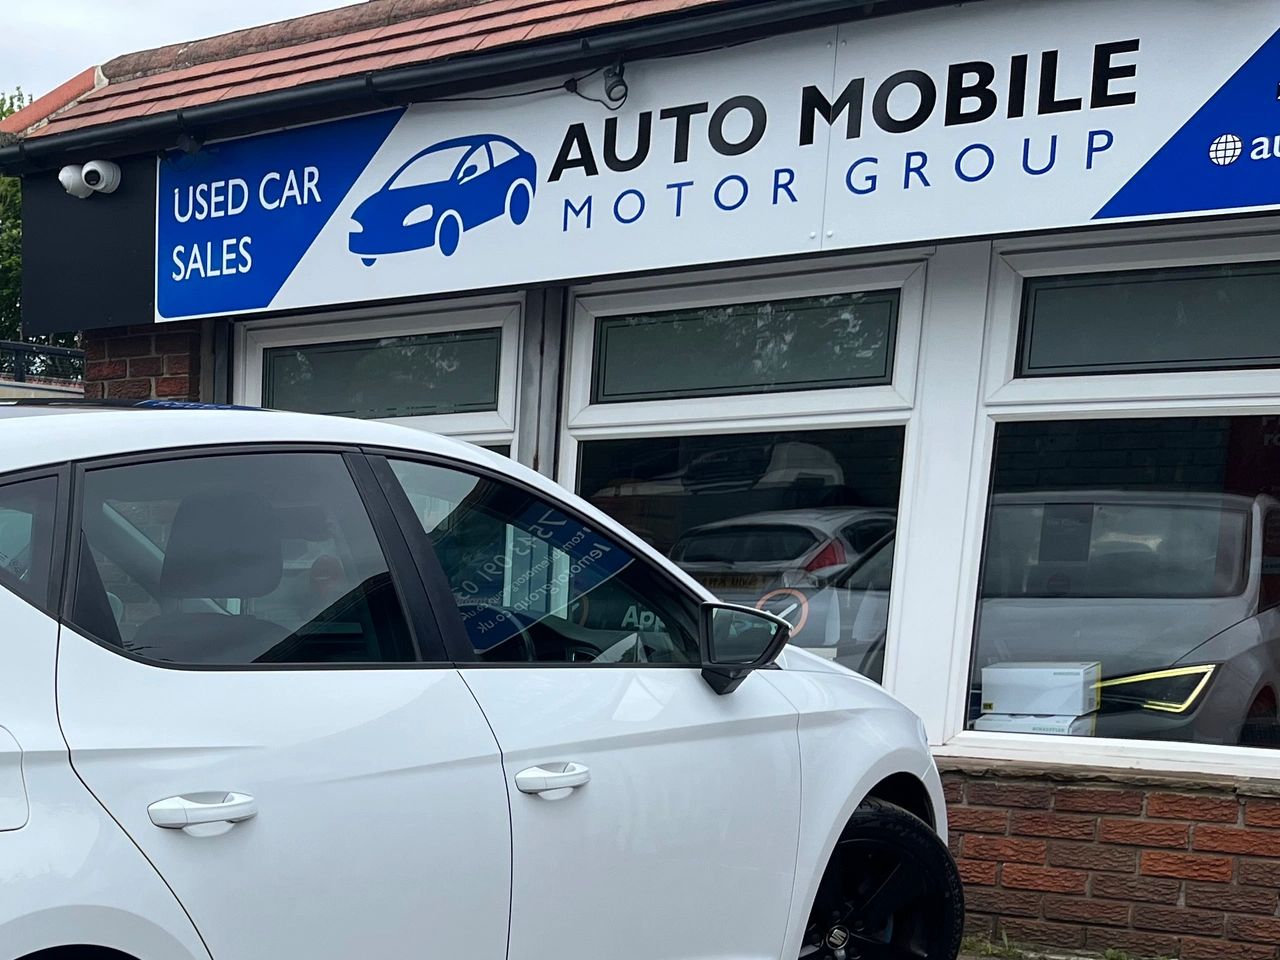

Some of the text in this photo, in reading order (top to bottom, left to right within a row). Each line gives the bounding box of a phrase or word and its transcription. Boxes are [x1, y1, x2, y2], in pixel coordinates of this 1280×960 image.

[547, 38, 1141, 183] AUTO MOBILE
[174, 166, 322, 223] USED CAR
[562, 129, 1114, 232] MOTOR GROUP
[172, 236, 252, 281] SALES
